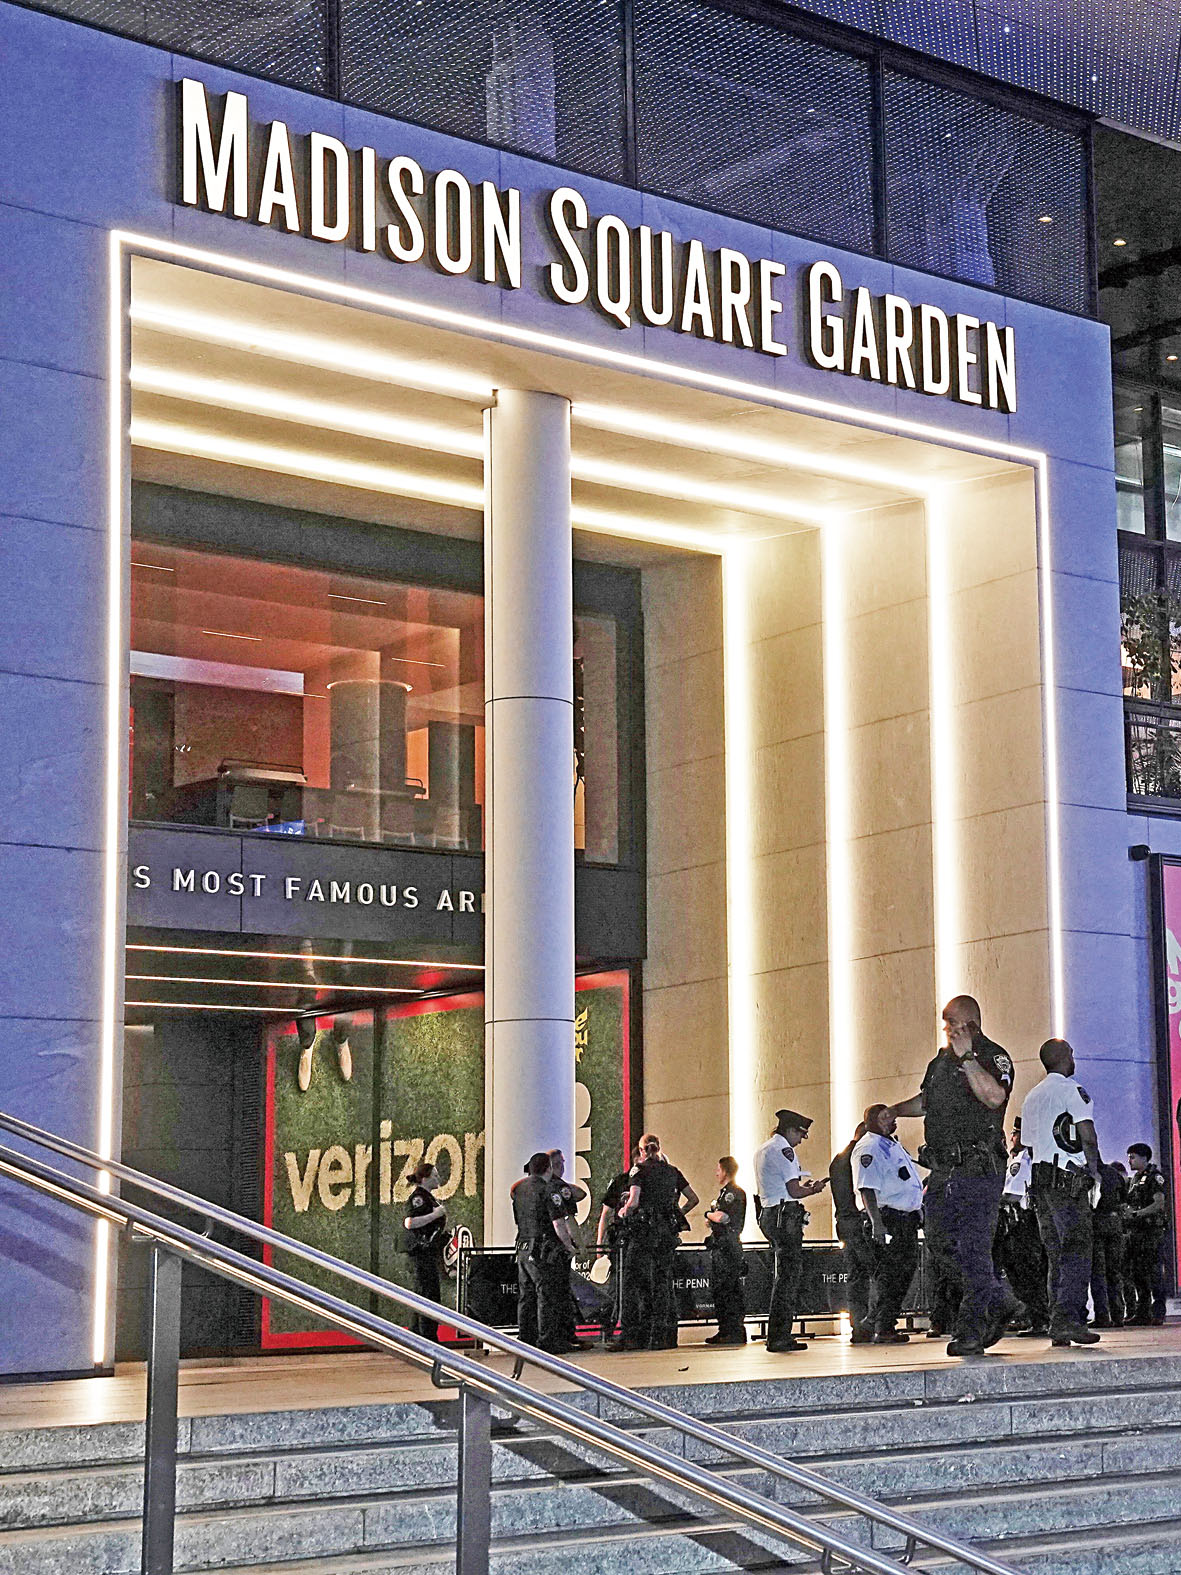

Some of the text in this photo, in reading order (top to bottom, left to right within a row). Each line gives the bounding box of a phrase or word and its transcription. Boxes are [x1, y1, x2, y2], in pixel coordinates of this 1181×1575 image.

[181, 77, 1017, 414] MADISON SQUARE GARDEN
[173, 868, 266, 897] MOST
[286, 877, 418, 908] FAMOUS
[436, 890, 483, 913] AR
[672, 1278, 710, 1289] HE PENN
[821, 1273, 848, 1283] THE PE
[500, 1283, 518, 1294] THE
